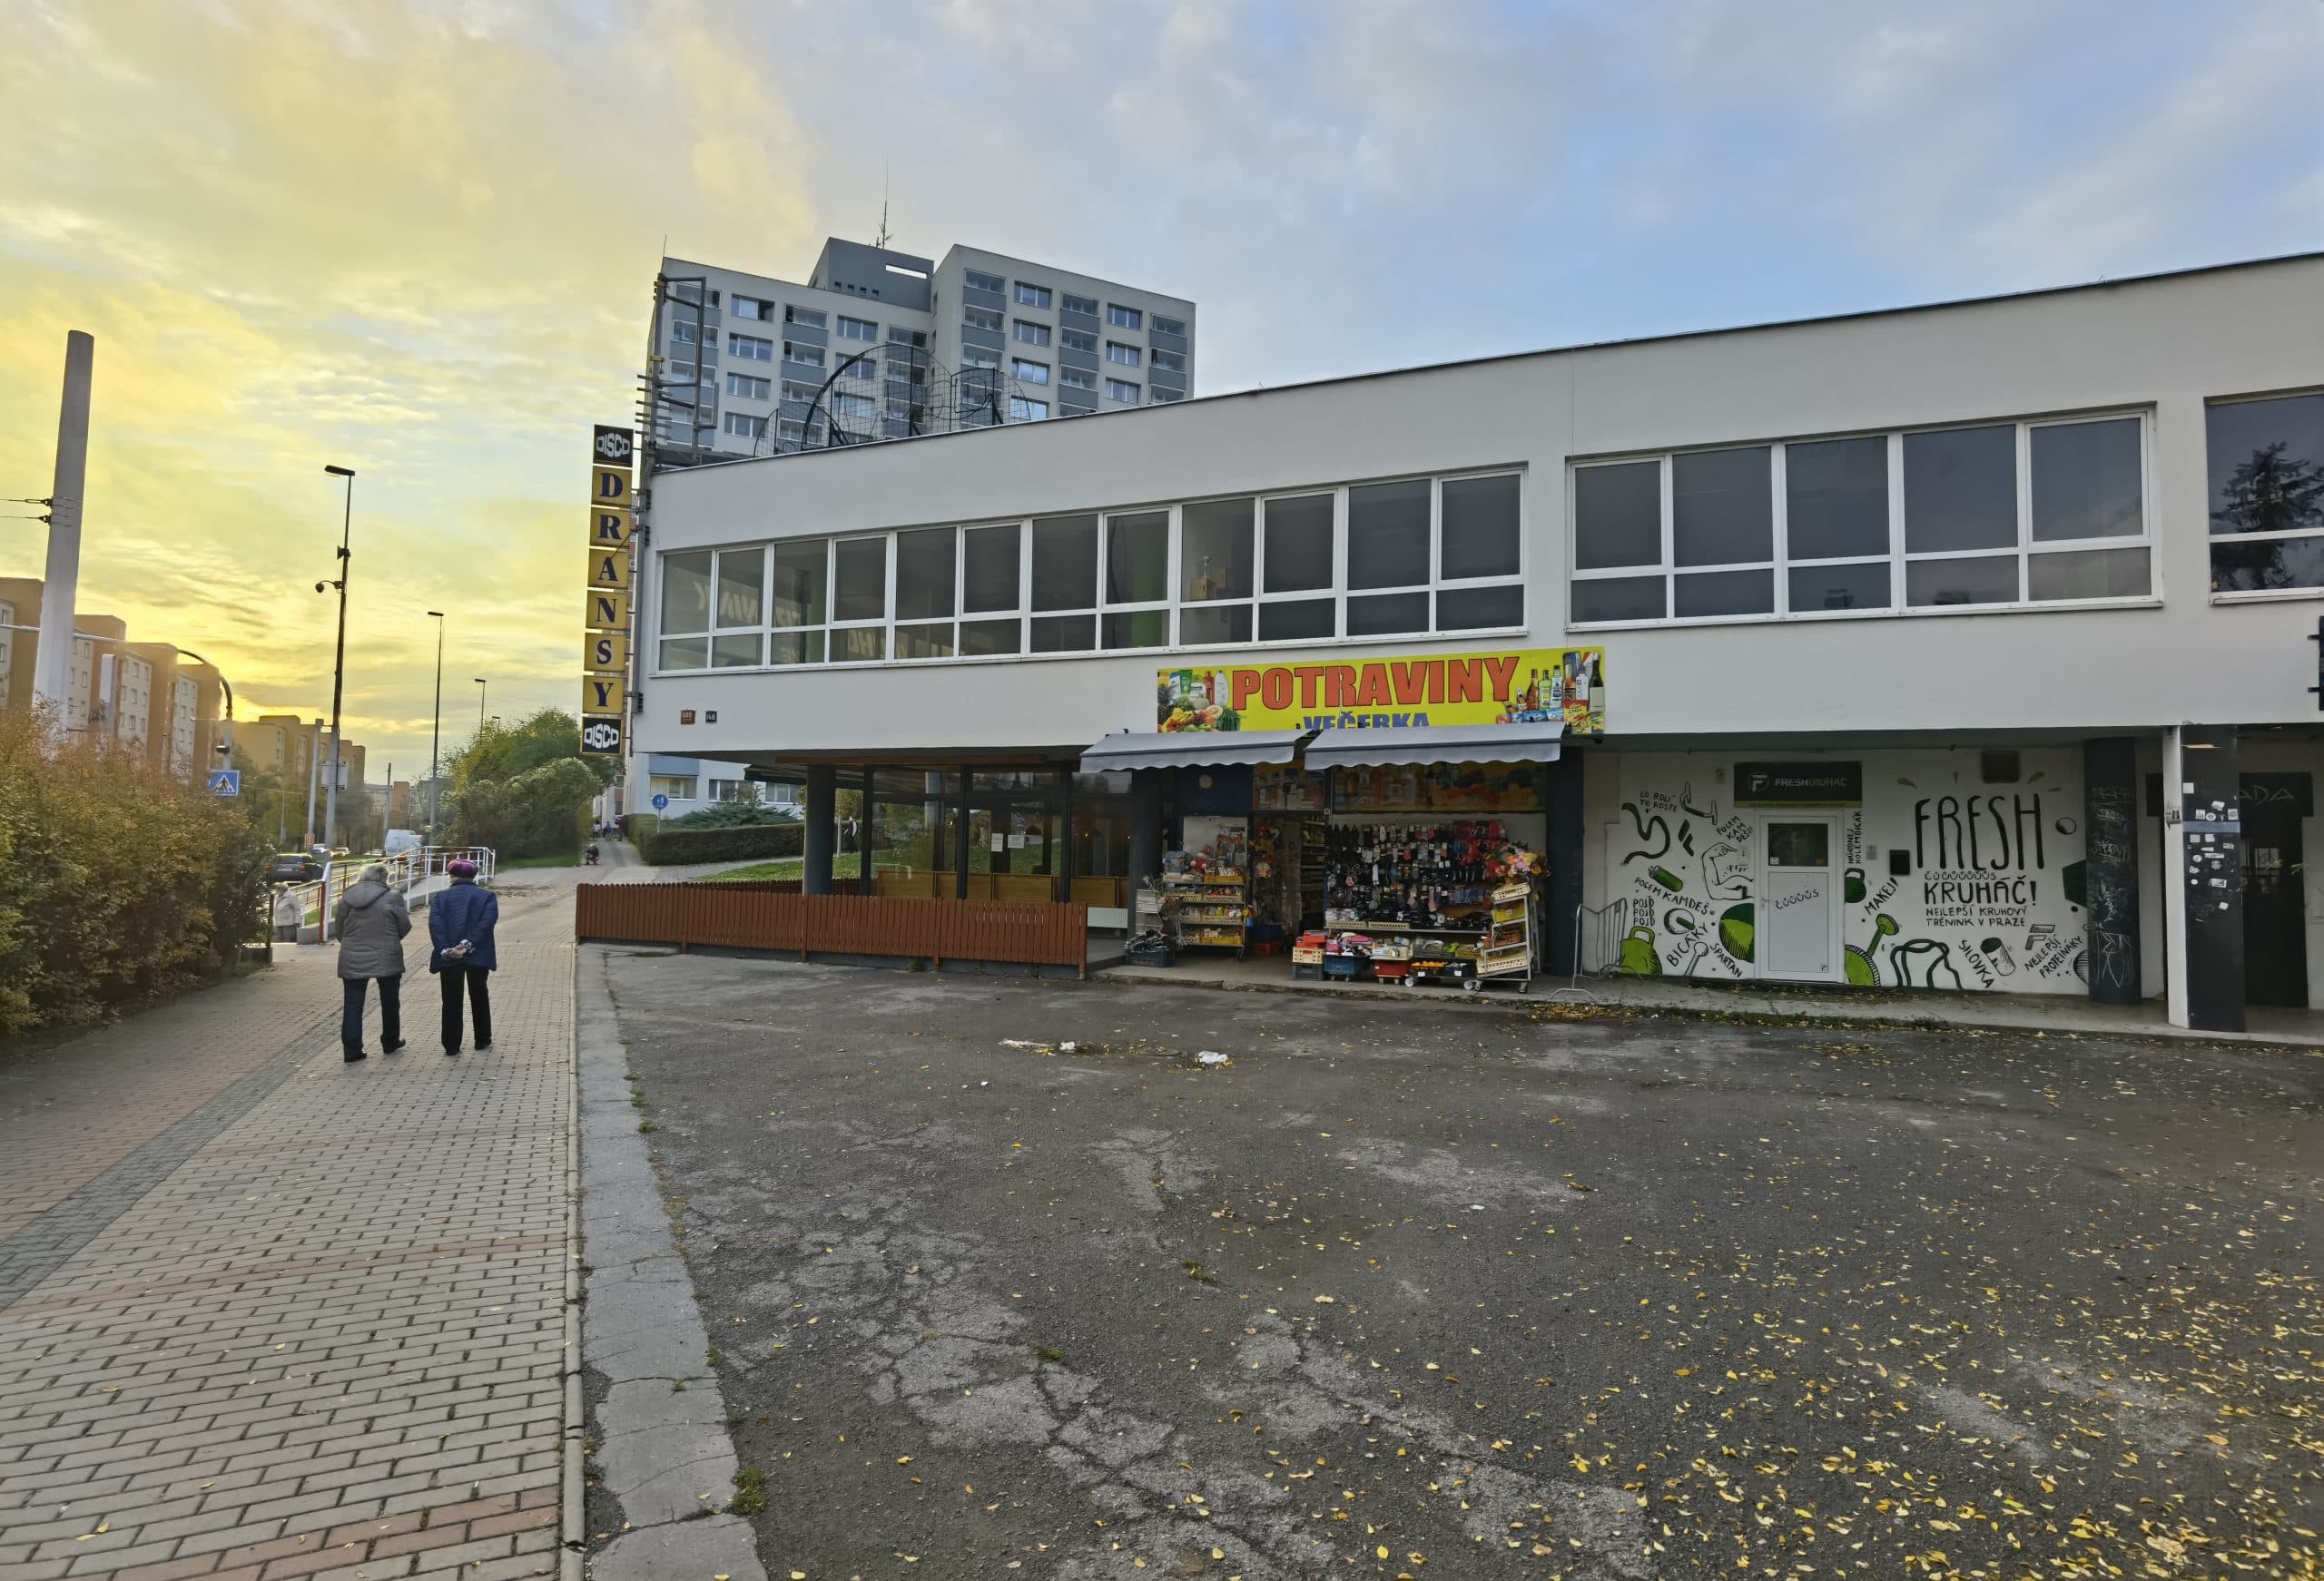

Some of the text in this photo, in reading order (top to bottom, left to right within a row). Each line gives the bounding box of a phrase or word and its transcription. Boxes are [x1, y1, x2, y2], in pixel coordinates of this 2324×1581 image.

[596, 432, 630, 457] DISCO
[593, 472, 623, 707] DRANSY
[1232, 656, 1521, 711] POTRAVINY
[584, 723, 619, 749] DISCO
[1727, 822, 1747, 840] KAM
[1915, 792, 2044, 870] FRESH
[1924, 875, 2037, 906] KRUHÁČ!
[1925, 904, 1974, 916] NEJLEPŠÍ
[1925, 916, 2026, 927] TRÉNINK V PRAZE
[1710, 943, 1743, 977] SPARTAN
[1958, 939, 1994, 988] SILOVKA
